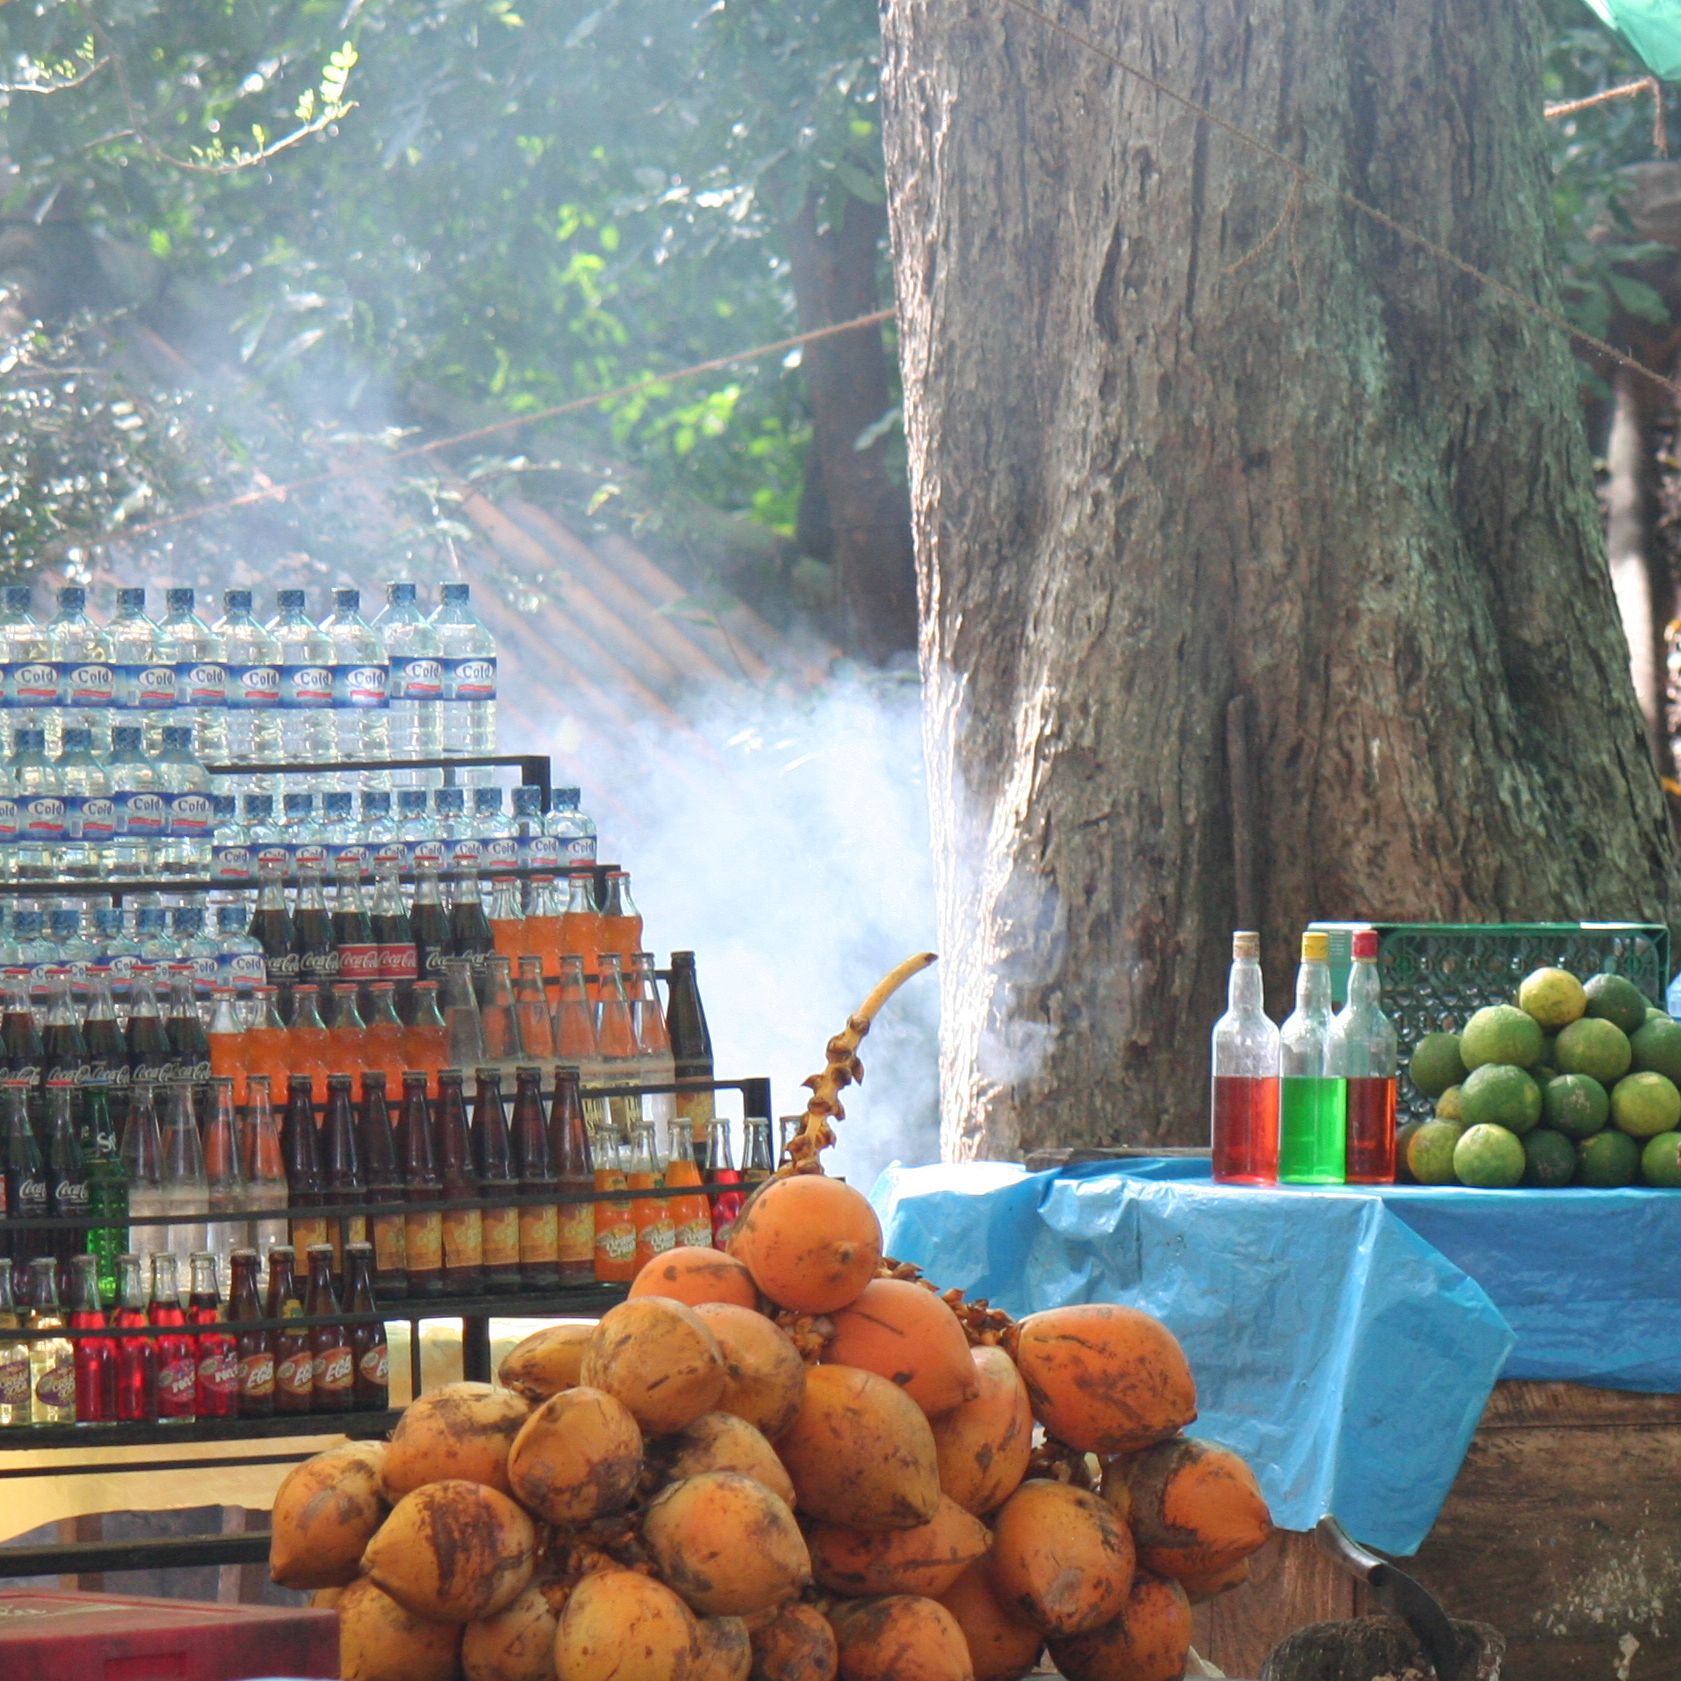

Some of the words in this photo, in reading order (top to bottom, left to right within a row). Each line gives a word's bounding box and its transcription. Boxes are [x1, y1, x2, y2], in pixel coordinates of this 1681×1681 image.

[21, 669, 53, 683] Cold
[78, 670, 109, 682] Cold
[196, 669, 222, 683] Cold
[249, 671, 277, 685] Cold
[300, 671, 329, 685] Cold
[412, 664, 440, 678] Cold
[463, 664, 491, 678] Cold
[145, 672, 173, 685] Cold
[354, 671, 382, 686] Cold
[0, 803, 15, 816] old
[34, 802, 64, 815] Cold
[88, 803, 112, 815] Cold
[133, 798, 160, 811] Cold
[178, 800, 207, 812] Cold
[247, 1360, 274, 1387] EGB
[325, 1353, 352, 1382] EGB
